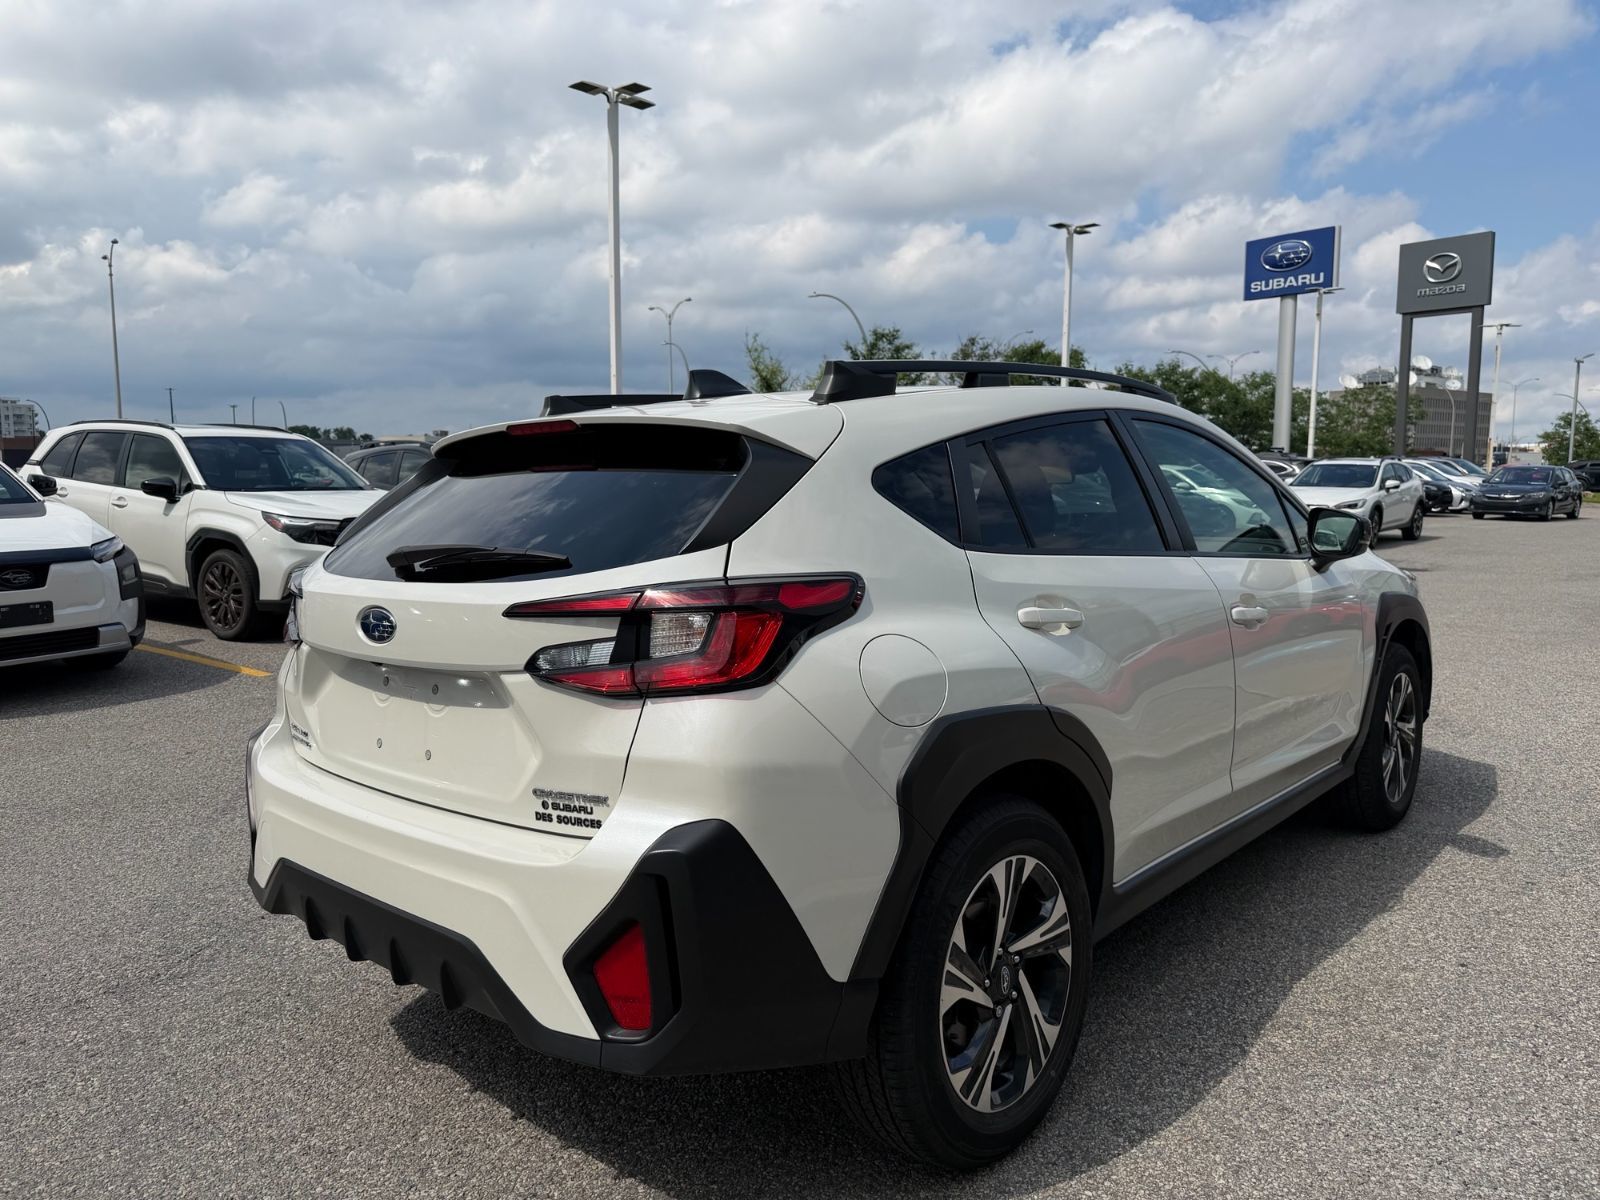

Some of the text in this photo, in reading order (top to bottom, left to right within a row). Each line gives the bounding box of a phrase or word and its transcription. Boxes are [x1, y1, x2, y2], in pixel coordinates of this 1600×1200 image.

[1250, 272, 1324, 293] SUBARU
[1416, 283, 1466, 297] mazda
[551, 801, 594, 815] SUBARU
[535, 811, 602, 829] DES SOURCES
